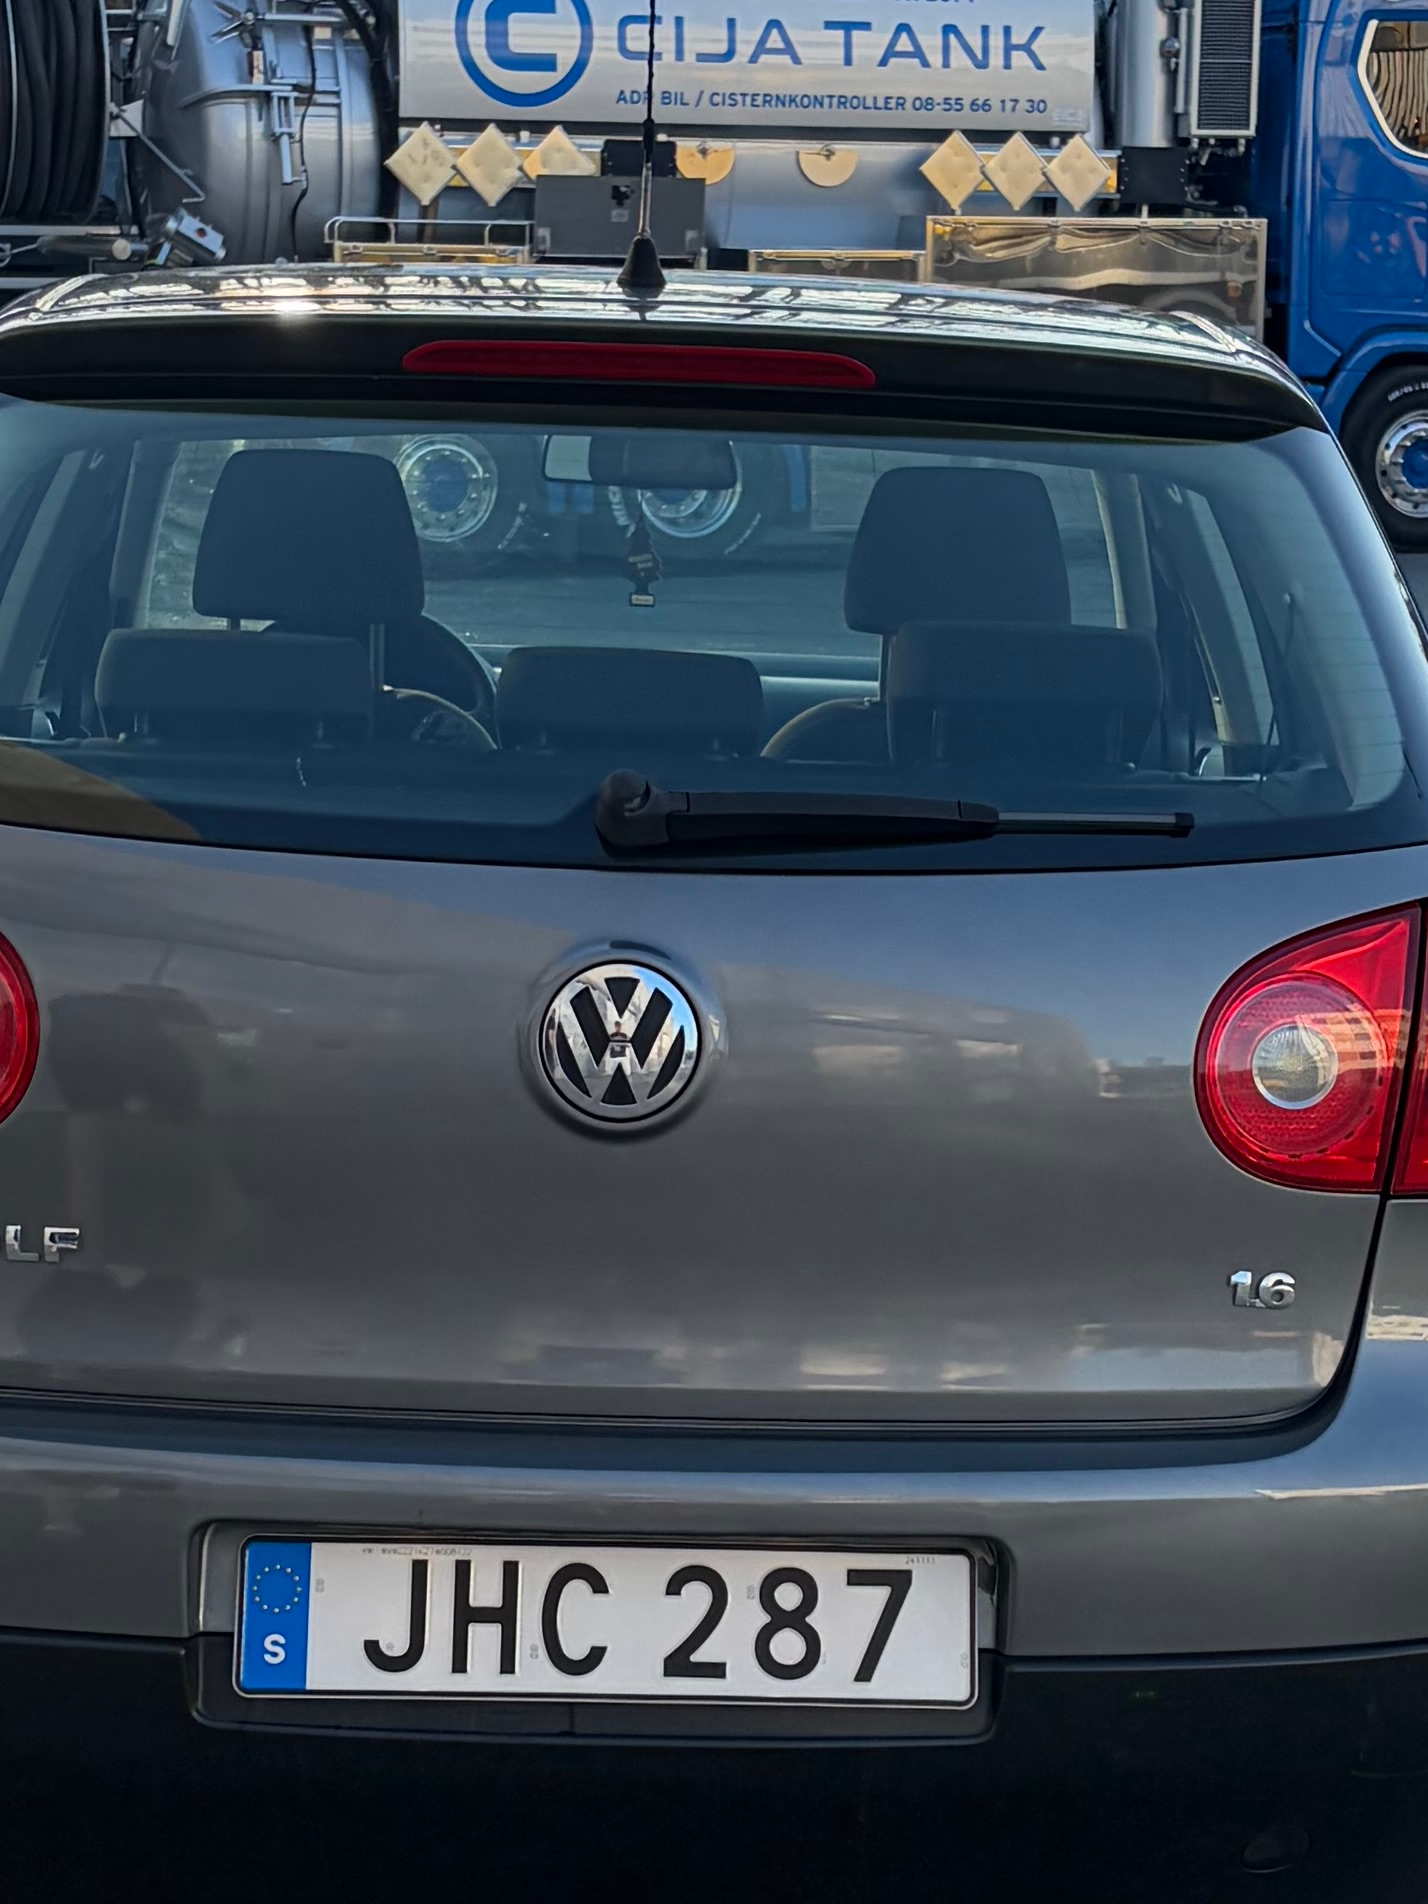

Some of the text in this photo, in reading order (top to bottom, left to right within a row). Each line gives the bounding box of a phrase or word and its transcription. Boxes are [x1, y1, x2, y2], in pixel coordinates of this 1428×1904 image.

[617, 14, 1047, 72] CIJA TANK
[661, 91, 690, 106] BIL
[709, 92, 906, 112] CISTERNKONTROLLER
[911, 96, 964, 113] 08-55
[969, 98, 993, 113] 66
[1000, 99, 1020, 114] 17
[1024, 99, 1048, 114] 30
[363, 1558, 913, 1683] JHC 287
[263, 1633, 287, 1665] S
